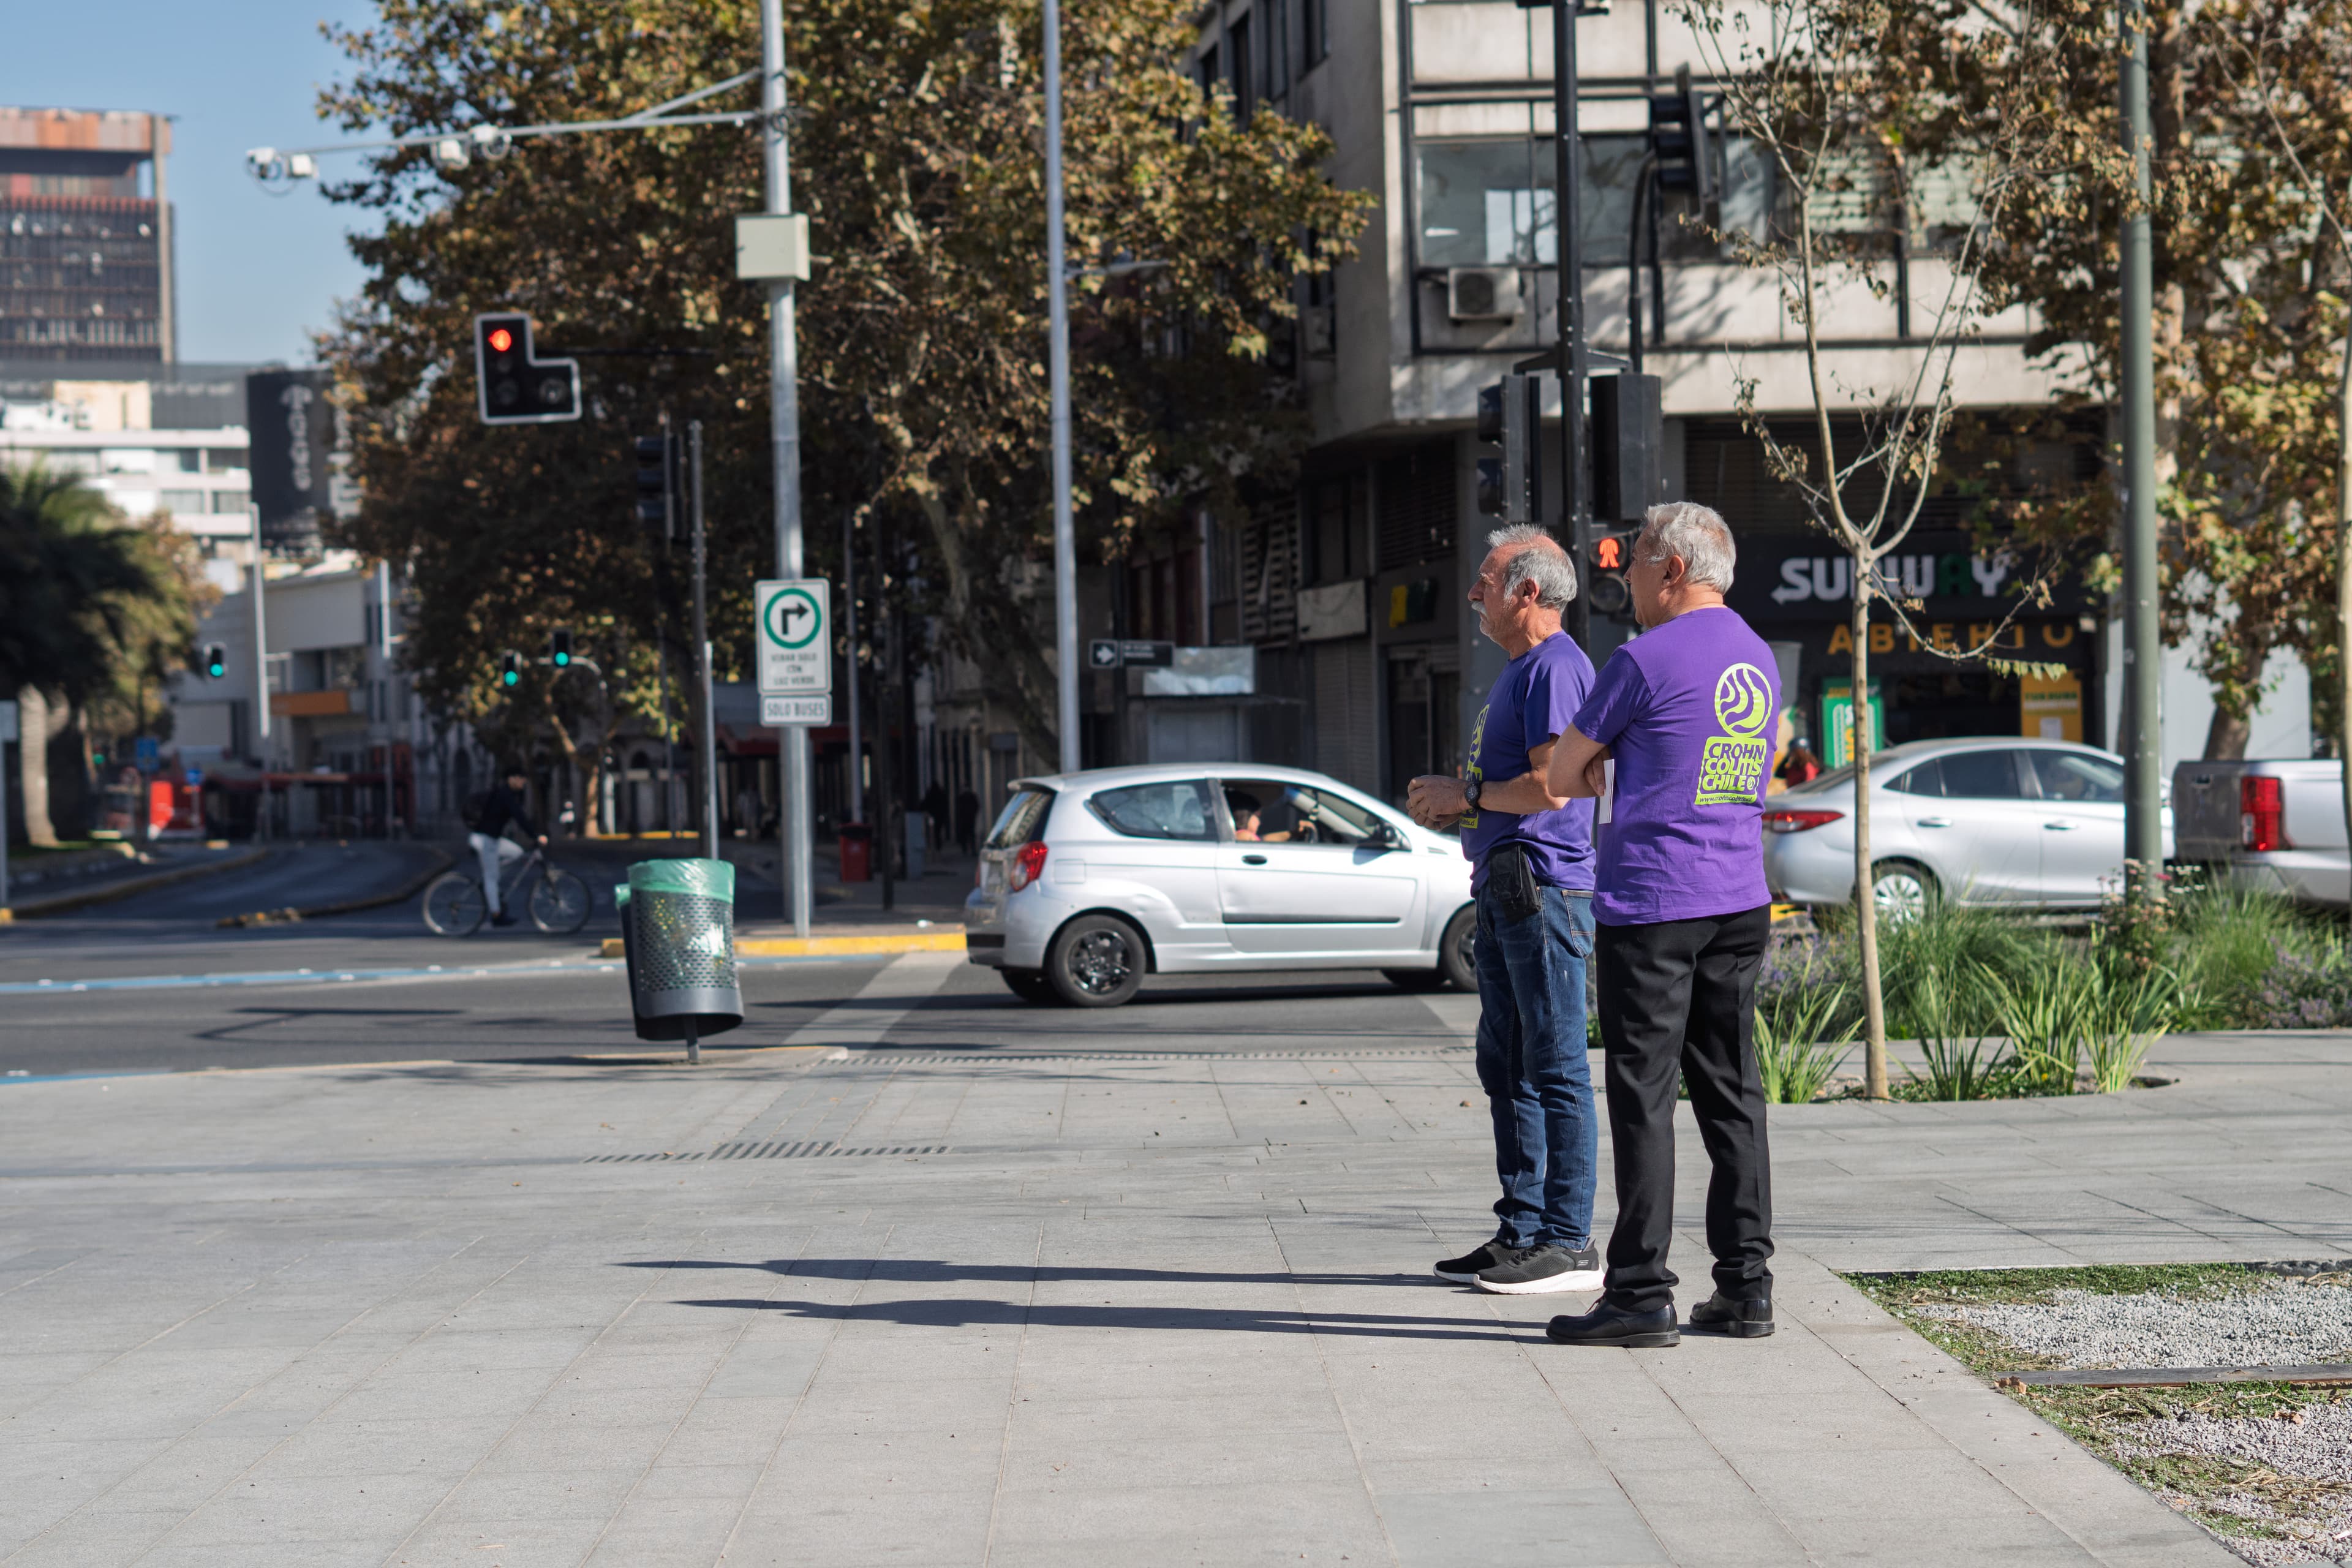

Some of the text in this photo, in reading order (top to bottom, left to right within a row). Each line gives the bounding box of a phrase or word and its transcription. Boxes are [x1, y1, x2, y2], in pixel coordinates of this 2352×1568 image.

[767, 702, 824, 716] SOLO BUSES
[1708, 742, 1765, 760] CROHN
[1705, 758, 1763, 776] COLITIS
[1702, 774, 1746, 791] CHILE
